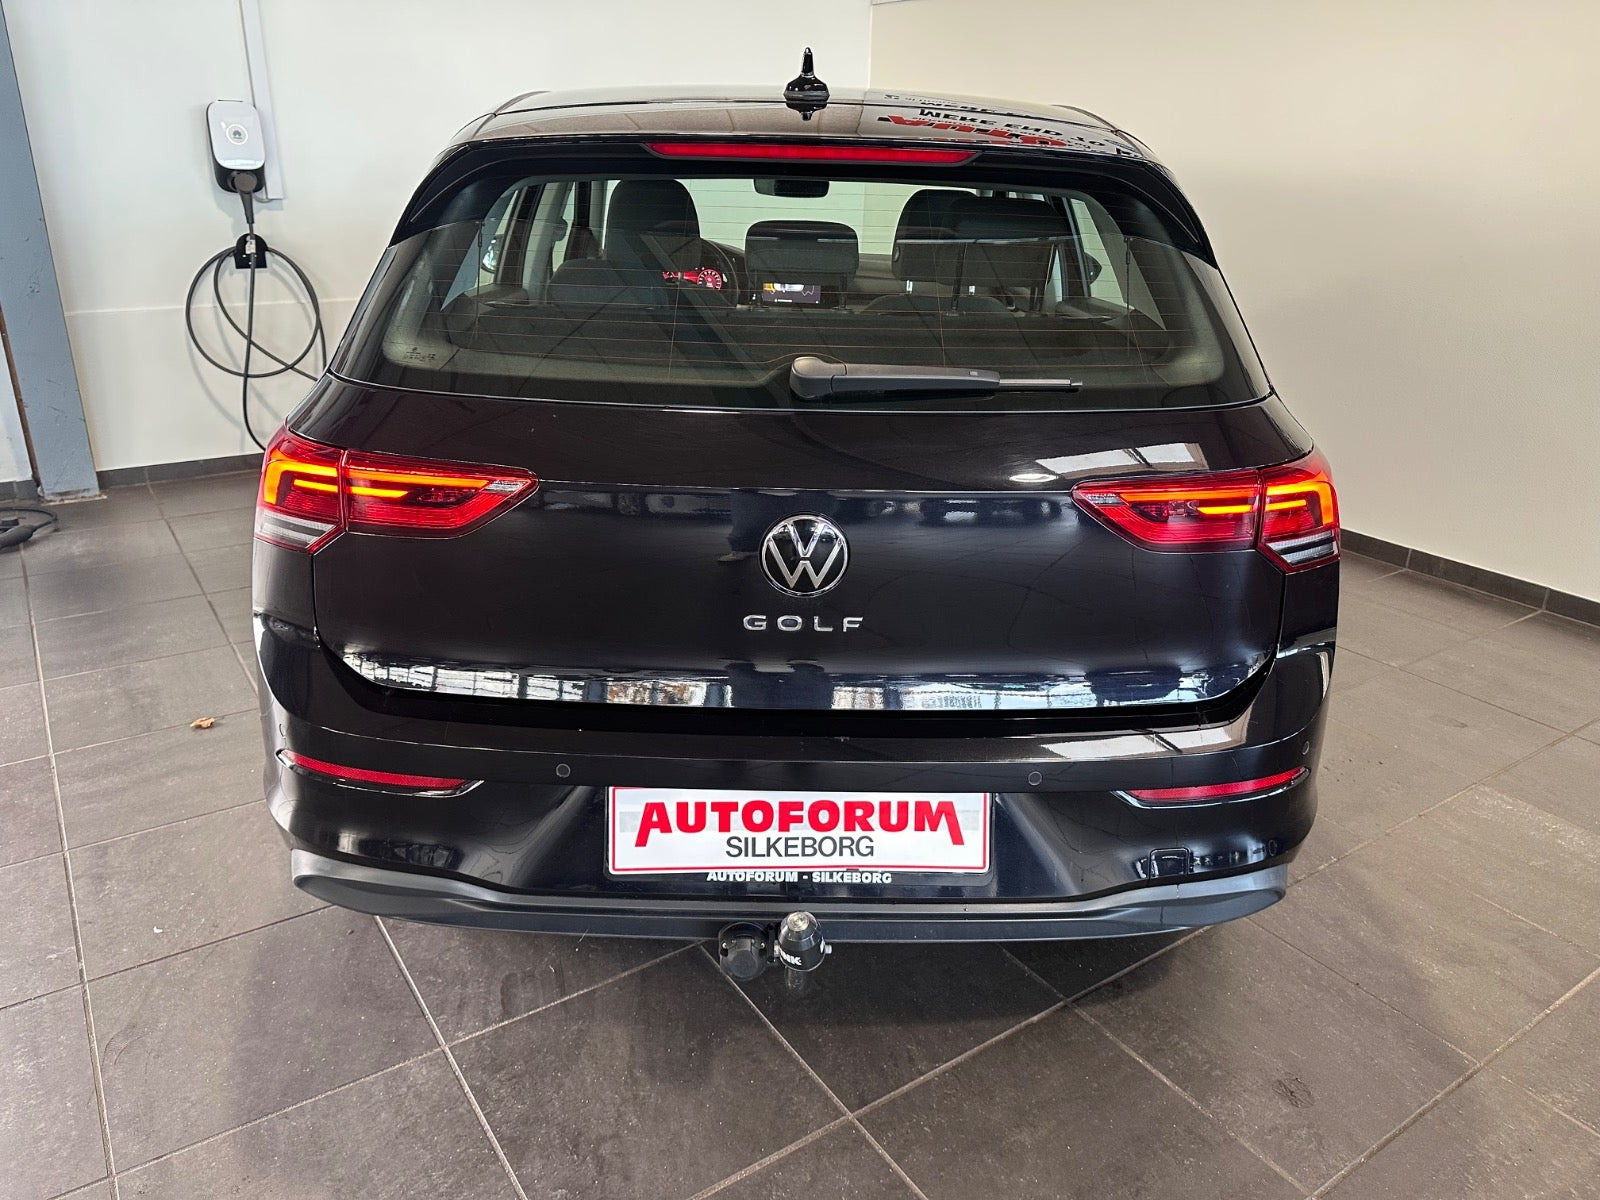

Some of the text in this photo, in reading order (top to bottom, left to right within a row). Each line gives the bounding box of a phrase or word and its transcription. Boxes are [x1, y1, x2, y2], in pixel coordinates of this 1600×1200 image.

[743, 614, 864, 632] GOLF
[635, 799, 965, 847] AUTOFORUM
[725, 835, 874, 858] SILKEBORG
[707, 871, 799, 883] AUTOFORUM
[812, 871, 892, 884] SILKEBORG
